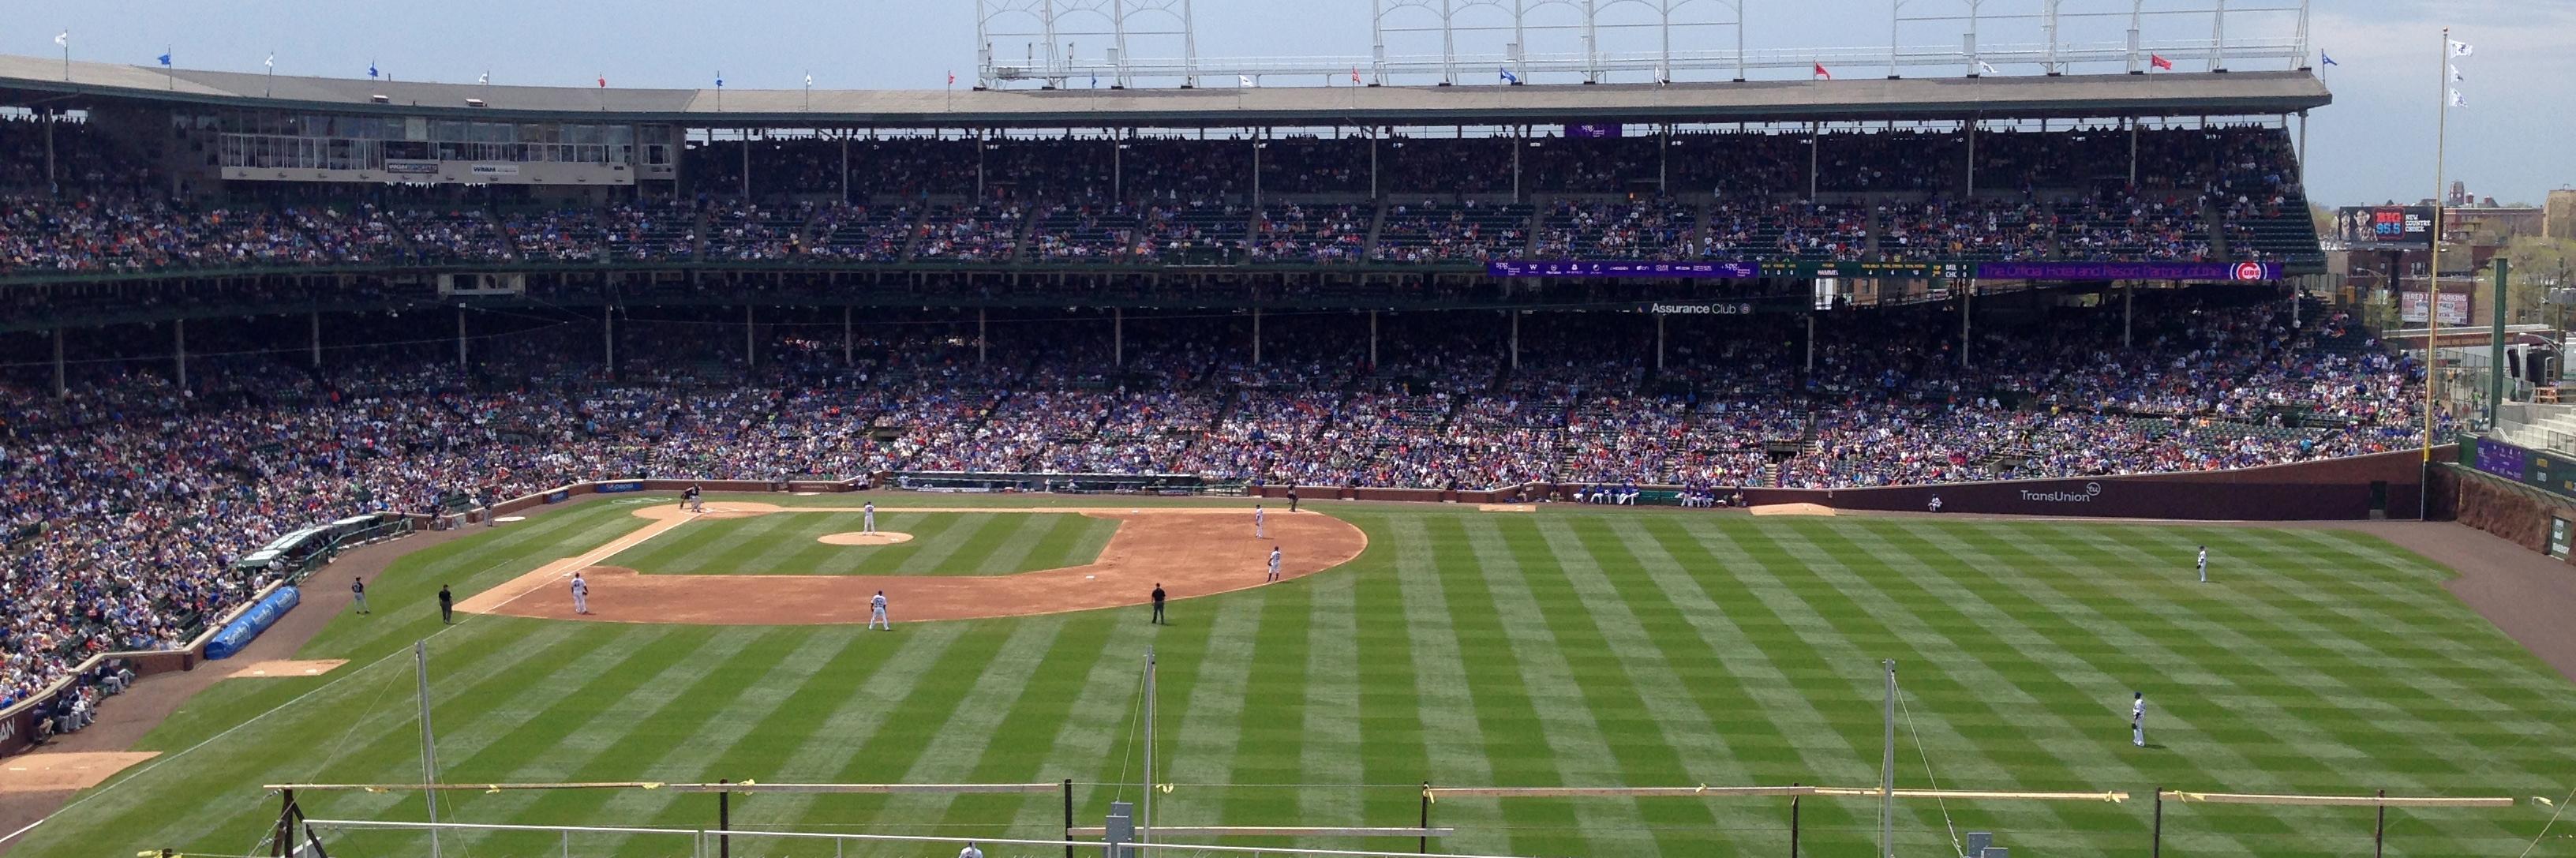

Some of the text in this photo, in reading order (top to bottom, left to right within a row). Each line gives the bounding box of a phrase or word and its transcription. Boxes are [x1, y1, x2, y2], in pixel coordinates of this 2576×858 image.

[2376, 212, 2401, 223] BIG
[2376, 223, 2401, 234] 95.5
[1651, 303, 1736, 314] Assurance Club
[2020, 489, 2091, 502] TransUnion
